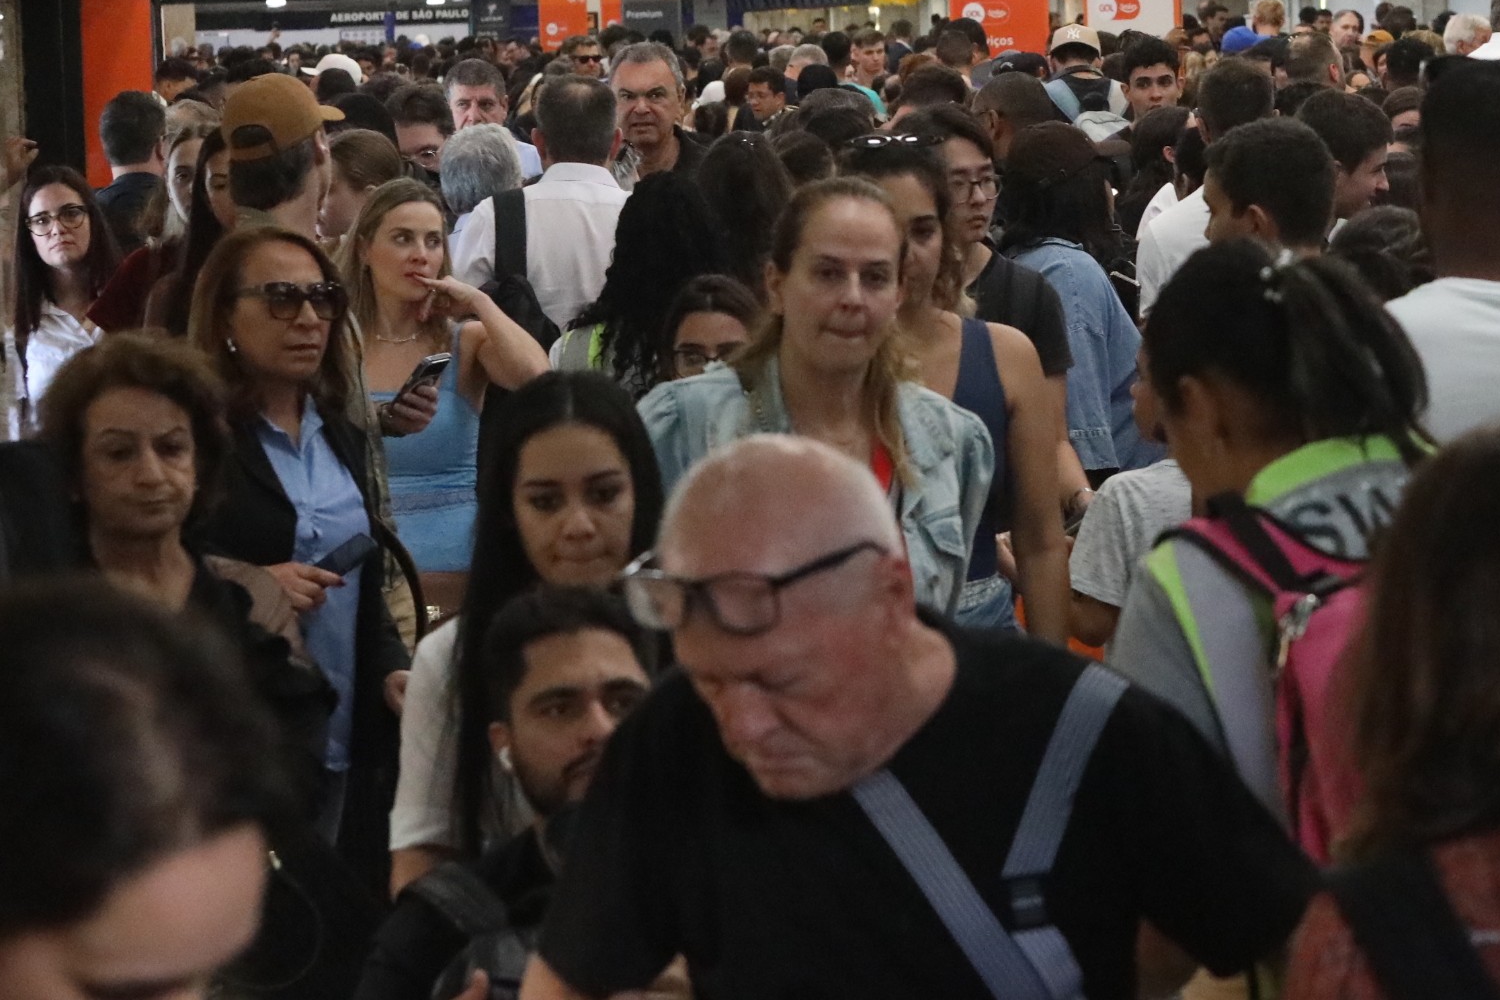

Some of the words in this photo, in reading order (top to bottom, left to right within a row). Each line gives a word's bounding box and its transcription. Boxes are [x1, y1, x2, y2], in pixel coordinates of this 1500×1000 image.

[330, 12, 386, 22] AEROPORT
[396, 11, 409, 20] DE
[412, 8, 432, 20] SÃO
[435, 9, 468, 18] PAULO
[626, 10, 663, 19] Premium
[987, 35, 1013, 48] viços
